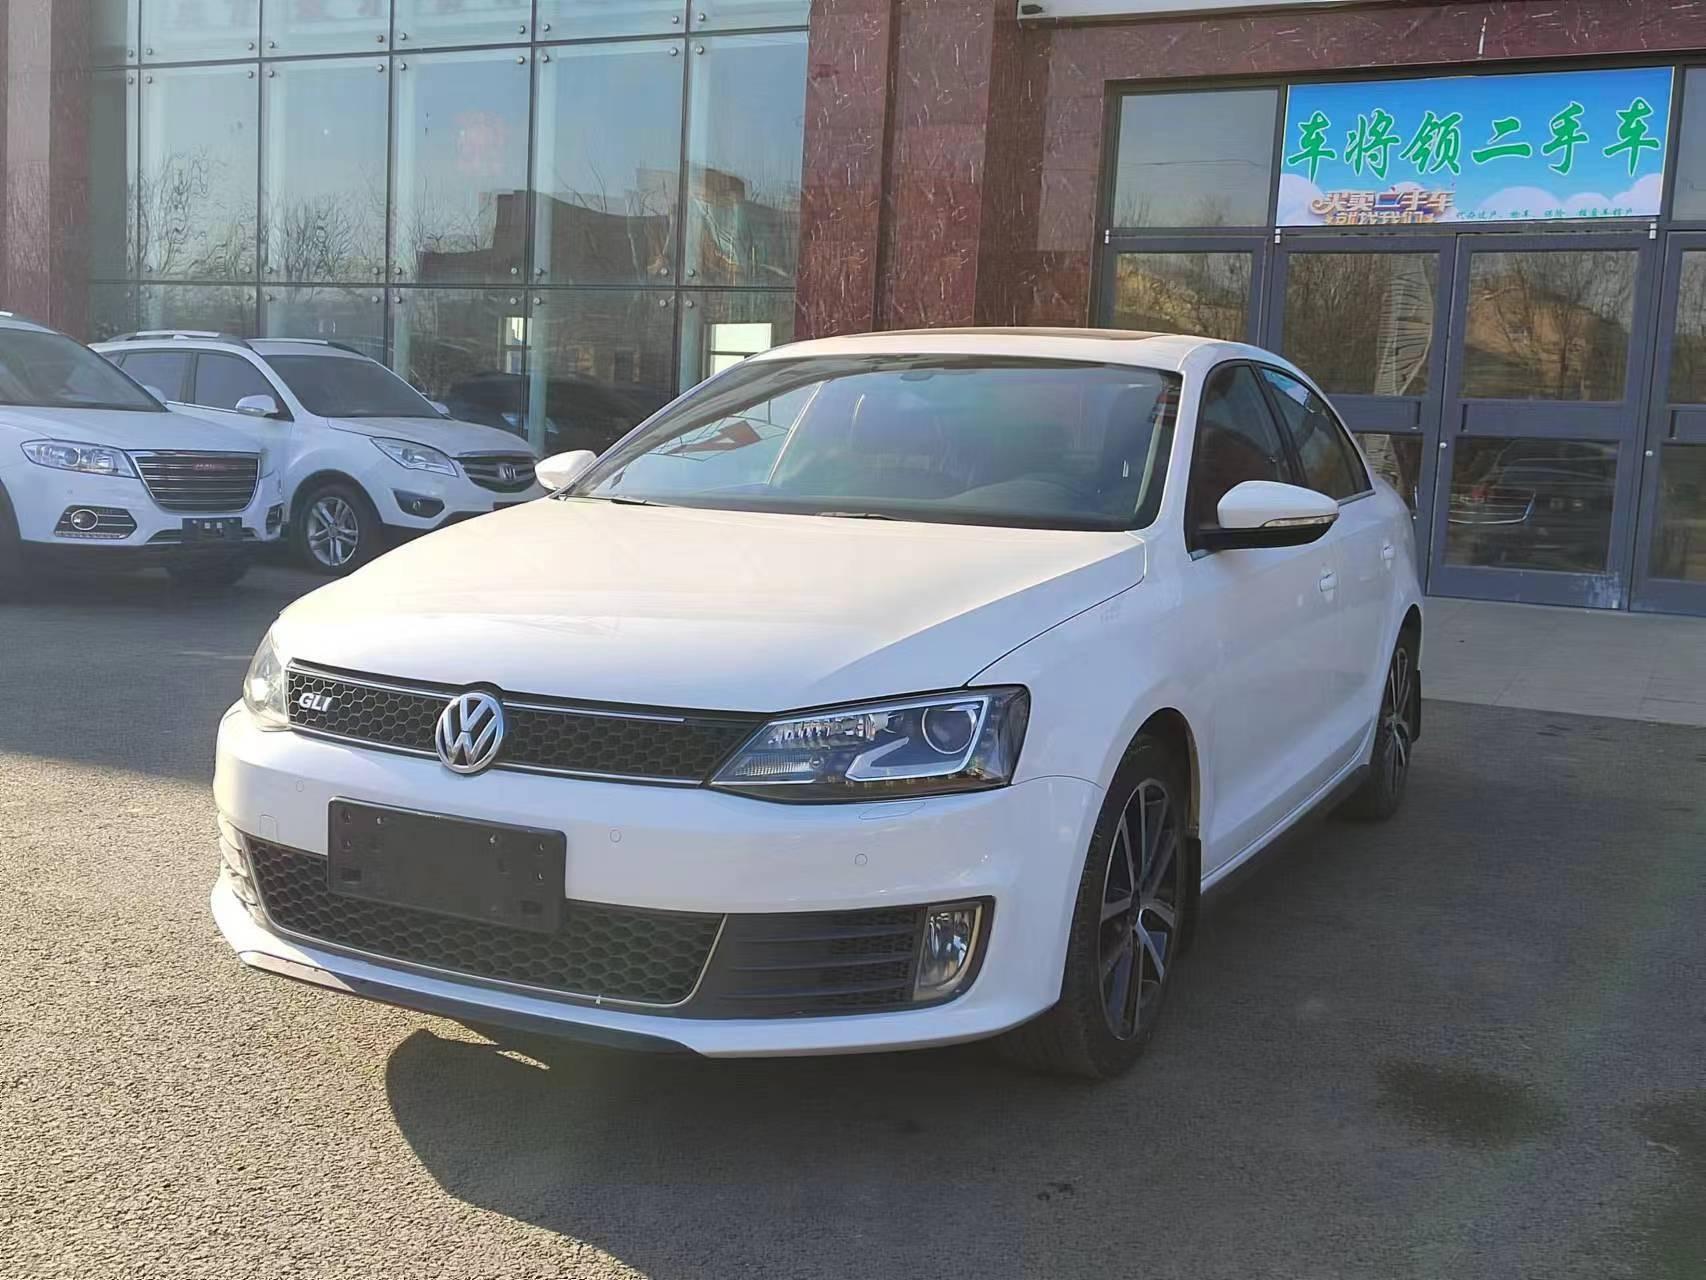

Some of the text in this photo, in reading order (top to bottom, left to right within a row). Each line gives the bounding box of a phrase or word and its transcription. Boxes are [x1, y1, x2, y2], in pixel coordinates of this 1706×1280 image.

[1287, 98, 1660, 183] 车将领二手车
[299, 693, 332, 712] GLI
